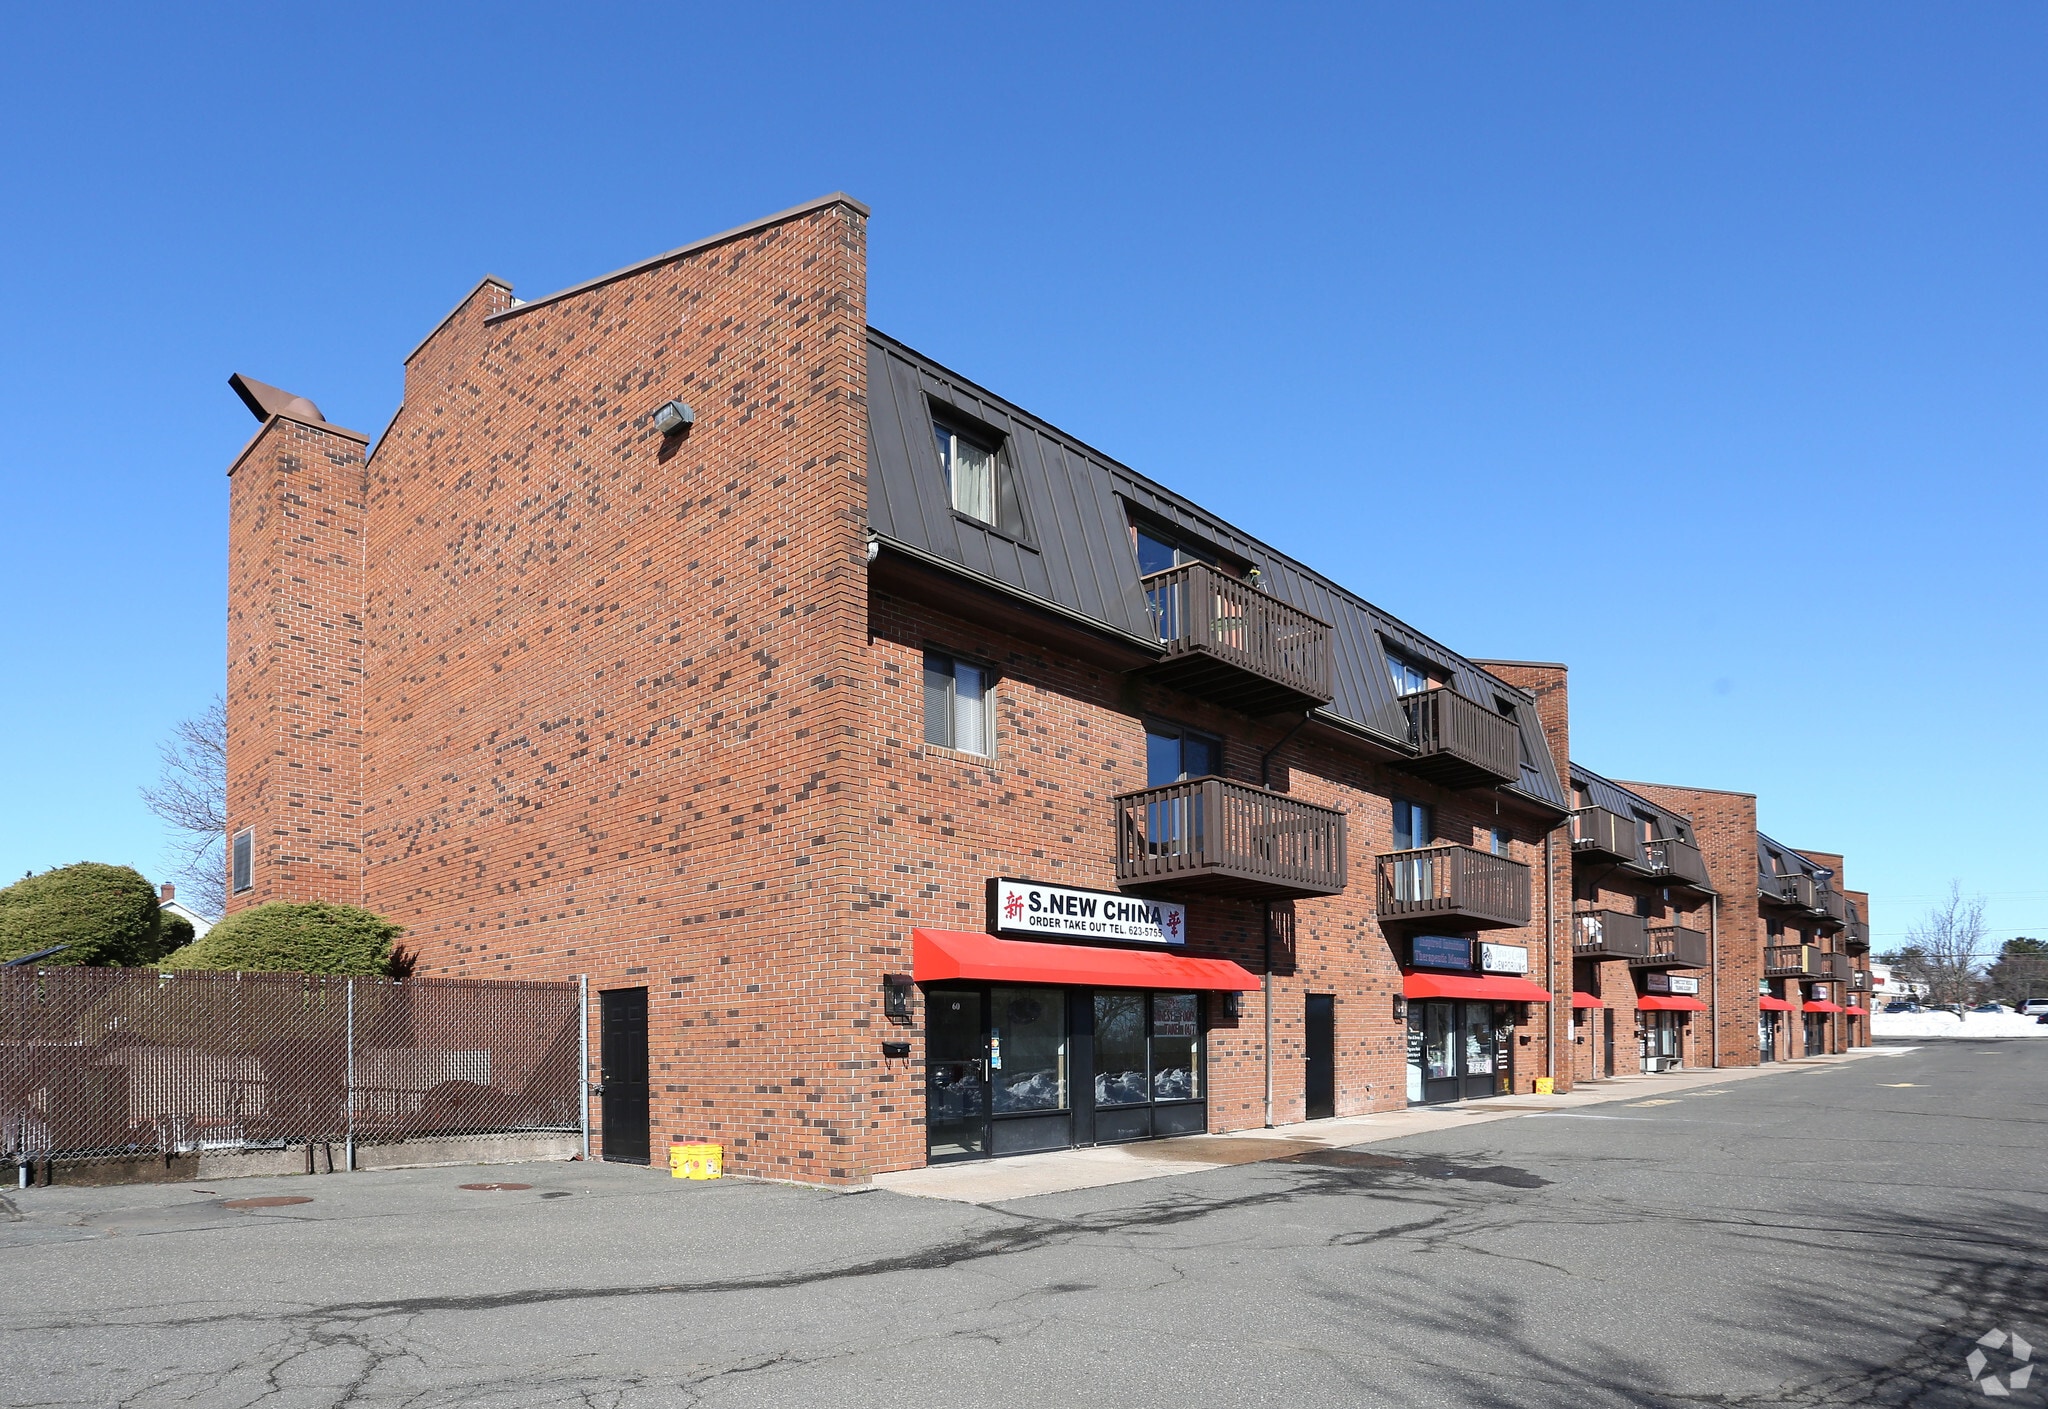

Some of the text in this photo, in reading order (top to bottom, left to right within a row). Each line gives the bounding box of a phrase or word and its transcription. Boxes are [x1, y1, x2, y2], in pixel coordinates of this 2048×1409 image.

[1003, 890, 1025, 923] 新
[1028, 890, 1163, 926] S.NEW CHINA
[1029, 915, 1163, 938] ORDER TAKE OUT TEL. 623-5755
[952, 1002, 960, 1011] 60
